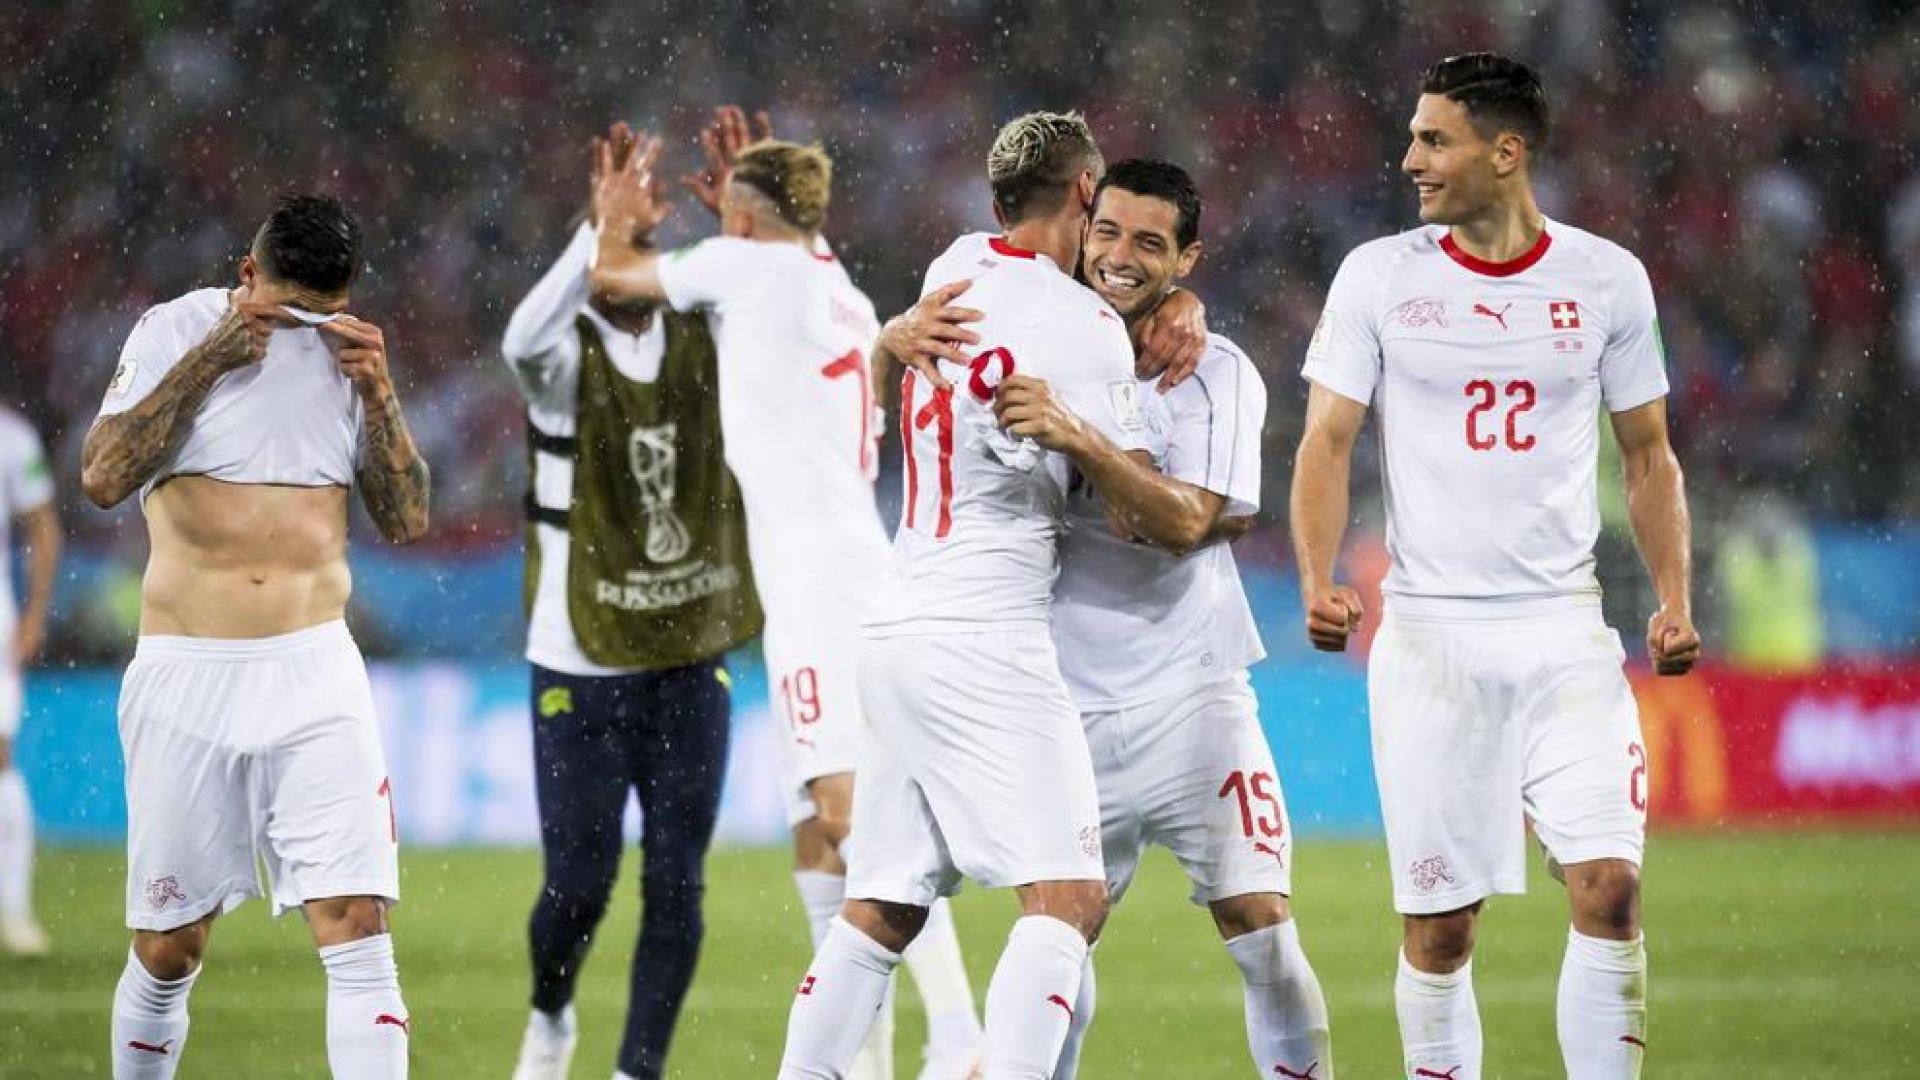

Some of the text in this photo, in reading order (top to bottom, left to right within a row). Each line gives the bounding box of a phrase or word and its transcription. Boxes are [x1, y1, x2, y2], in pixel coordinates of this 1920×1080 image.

[1464, 379, 1535, 452] 22
[782, 667, 821, 728] 19
[1217, 771, 1282, 838] 15
